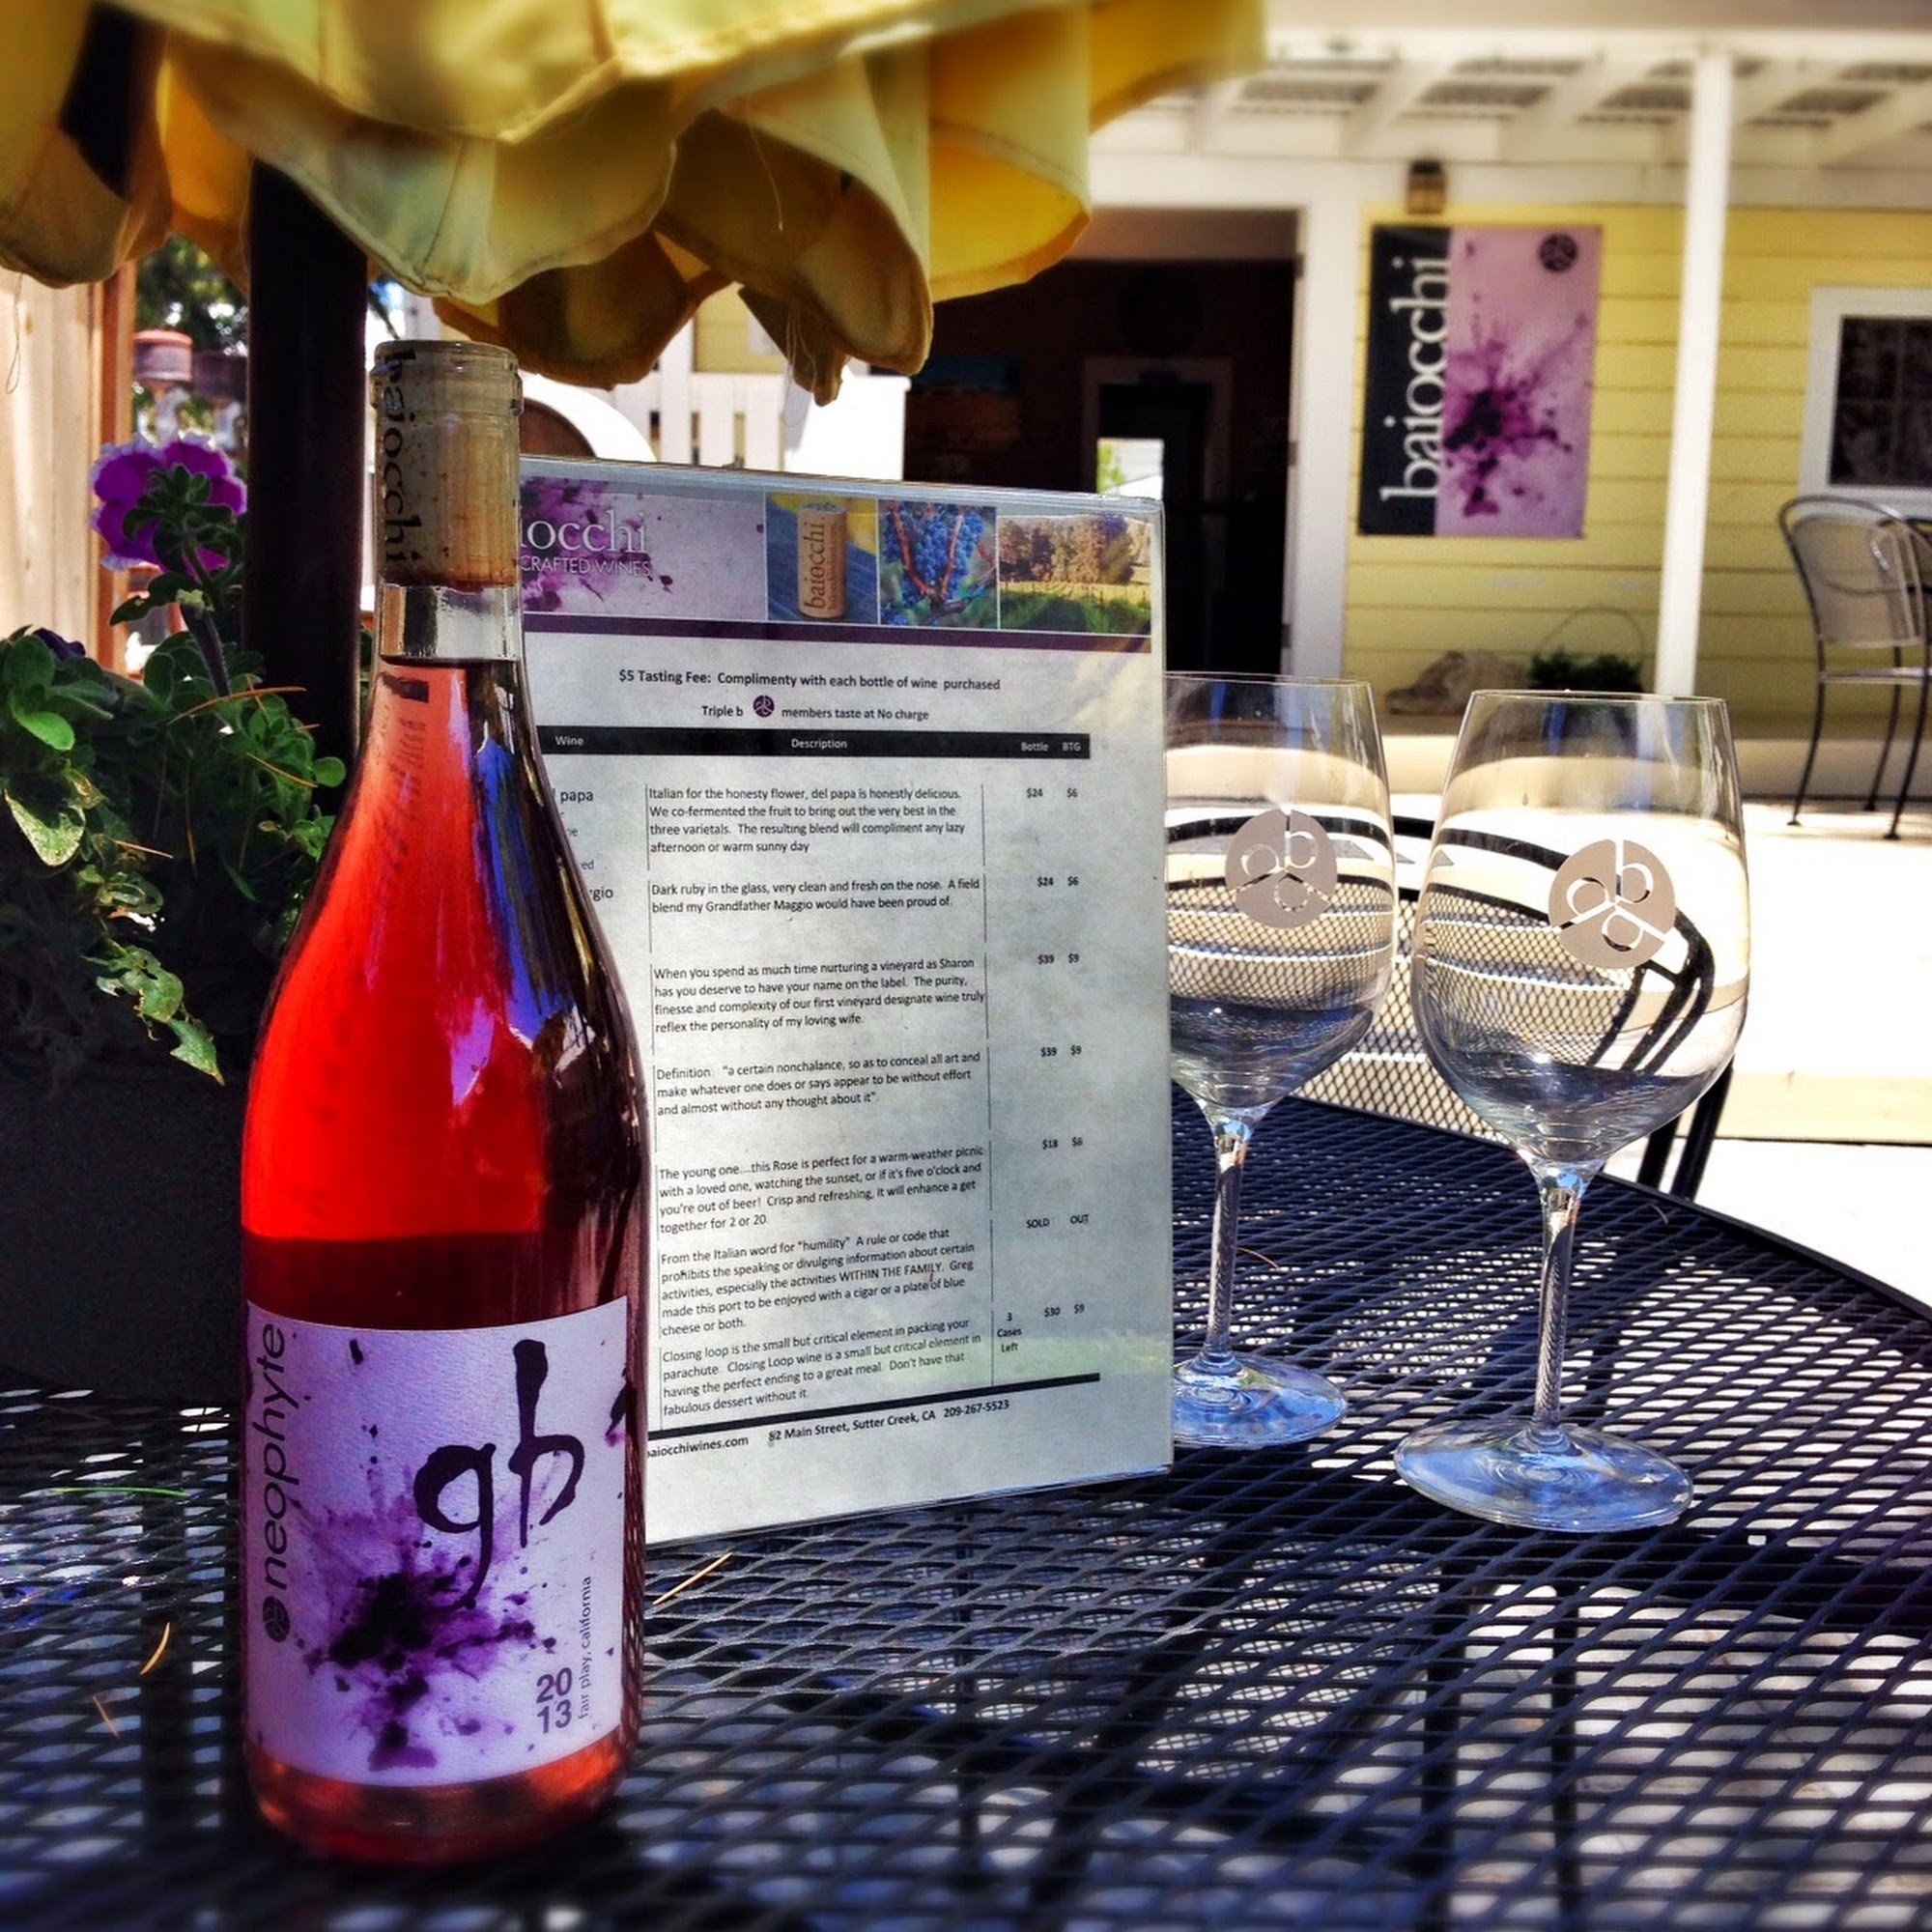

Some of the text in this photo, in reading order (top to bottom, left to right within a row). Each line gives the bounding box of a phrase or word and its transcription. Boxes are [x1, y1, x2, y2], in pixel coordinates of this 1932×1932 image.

[1379, 256, 1450, 501] baiocchi
[595, 559, 651, 577] WINES
[619, 667, 1001, 693] $5 Tasting Fee: Complimenty with each bottle of wine purchased
[701, 702, 734, 720] Triple
[781, 706, 832, 720] members
[835, 707, 862, 720] taste
[864, 708, 874, 720] at
[877, 707, 893, 721] No
[894, 707, 929, 724] charge
[554, 735, 1081, 752] Wine Description Bottle BTG
[560, 790, 594, 804] papa
[648, 786, 683, 800] Italian
[686, 786, 702, 800] for
[704, 786, 724, 800] the
[725, 786, 768, 803] honesty
[771, 786, 808, 801] flower,
[810, 786, 828, 799] del
[830, 790, 856, 803] papa
[868, 786, 913, 803] honestly
[1026, 787, 1078, 799] $24 $6
[649, 804, 956, 820] We co-fermented the fruit to bring out the very best in the
[651, 882, 677, 895] Dark
[680, 882, 705, 897] ruby
[707, 882, 718, 894] in
[721, 881, 739, 894] the
[741, 880, 770, 896] glass,
[772, 884, 796, 895] very
[798, 879, 827, 893] clean
[829, 879, 849, 892] and
[851, 878, 878, 892] fresh
[880, 882, 894, 891] on
[895, 877, 914, 891] the
[956, 876, 980, 890] field
[1037, 876, 1079, 888] $24 $6
[652, 899, 683, 913] blend
[686, 903, 703, 915] my
[705, 898, 771, 912] Grandfather
[773, 897, 813, 913] Maggio
[815, 895, 848, 909] would
[850, 895, 875, 908] have
[877, 895, 904, 908] been
[906, 894, 937, 910] proud
[654, 966, 687, 979] When
[689, 969, 709, 981] you
[712, 963, 745, 980] spend
[747, 967, 759, 976] as
[761, 962, 791, 976] much
[793, 962, 817, 975] time
[820, 960, 869, 976] nurturing
[879, 957, 923, 974] vineyard
[925, 961, 937, 970] as
[939, 956, 975, 970] Sharon
[1037, 952, 1080, 965] $39 $9
[655, 1019, 687, 1033] reflex
[689, 1018, 707, 1031] the
[710, 1015, 769, 1033] personality
[771, 1014, 783, 1027] of
[785, 1017, 802, 1030] my
[804, 1013, 837, 1028] loving
[1040, 1045, 1082, 1058] $39 $9
[657, 1067, 972, 1096] make whatever one does or says appear to be without effort
[1042, 1139, 1059, 1151] $18
[660, 1217, 707, 1234] together
[710, 1215, 726, 1228] for
[738, 1216, 750, 1226] or
[1026, 1214, 1090, 1229] SOLD OUT
[662, 1260, 974, 1299] activities, especially the activities WITHIN THE FAMILY. Greg
[1044, 1307, 1061, 1318] $30
[1074, 1303, 1085, 1314] $9
[997, 1327, 1022, 1338] Cases
[1001, 1342, 1018, 1352] Left
[664, 1399, 711, 1414] fabulous
[713, 1394, 753, 1408] dessert
[754, 1389, 796, 1404] without
[784, 1424, 811, 1438] Main
[814, 1420, 850, 1435] Street,
[852, 1416, 885, 1430] Sutter
[887, 1409, 920, 1426] Creek,
[921, 1407, 936, 1421] CA
[941, 1398, 1010, 1418] 209-267-5523
[252, 1323, 299, 1590] neophyte
[579, 1577, 591, 1649] california
[536, 1667, 573, 1704] 20
[537, 1698, 572, 1734] 13
[578, 1694, 588, 1719] fair
